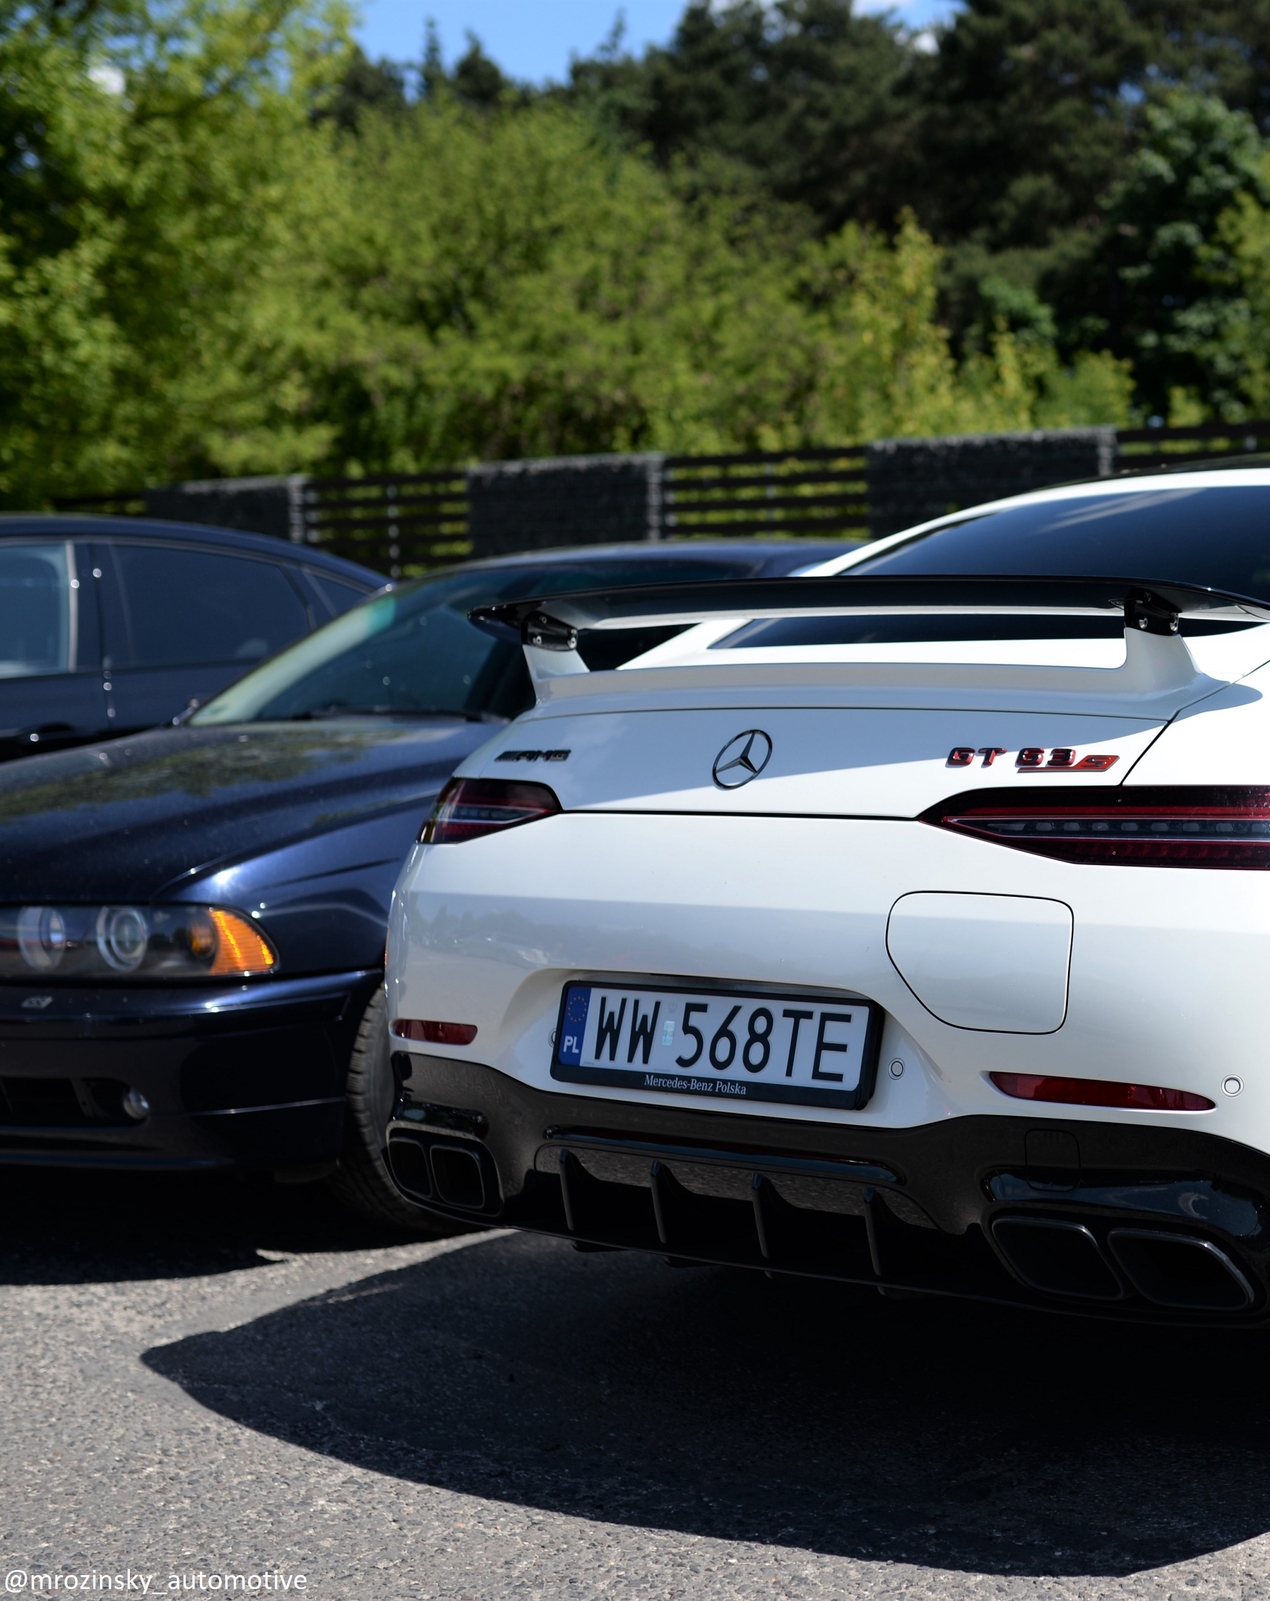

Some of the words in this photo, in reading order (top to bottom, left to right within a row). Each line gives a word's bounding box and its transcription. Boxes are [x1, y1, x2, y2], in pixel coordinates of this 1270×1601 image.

[512, 749, 571, 762] AMG
[947, 747, 1007, 766] GT
[563, 1035, 580, 1054] PL
[594, 996, 661, 1065] WW
[675, 1002, 852, 1083] 568TE
[644, 1074, 714, 1092] Mercedes-Benz
[715, 1080, 747, 1095] Polska
